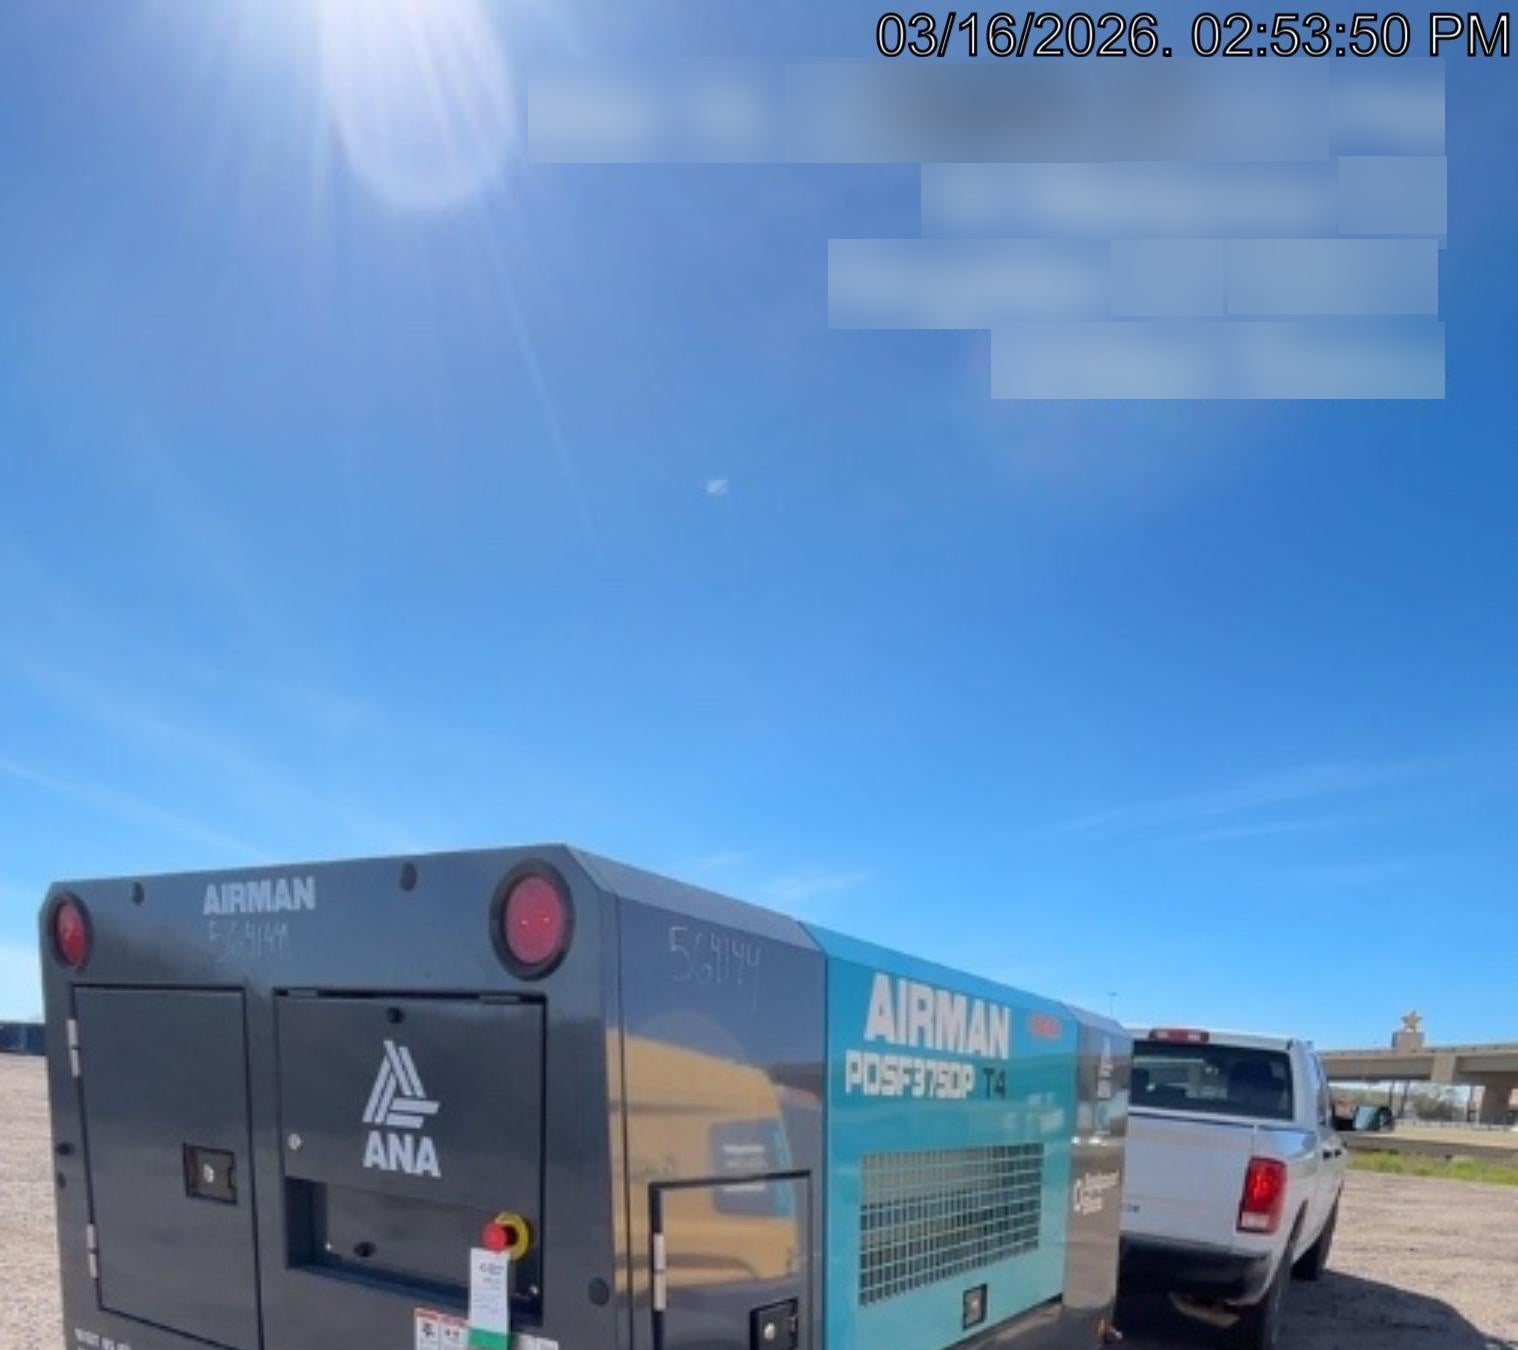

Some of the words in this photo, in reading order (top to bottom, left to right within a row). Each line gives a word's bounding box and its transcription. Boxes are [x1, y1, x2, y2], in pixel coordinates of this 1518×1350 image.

[203, 876, 316, 915] AIRMAN
[863, 971, 1011, 1060] AIRMAN
[983, 1066, 1007, 1099] T4
[362, 1130, 442, 1177] ANA
